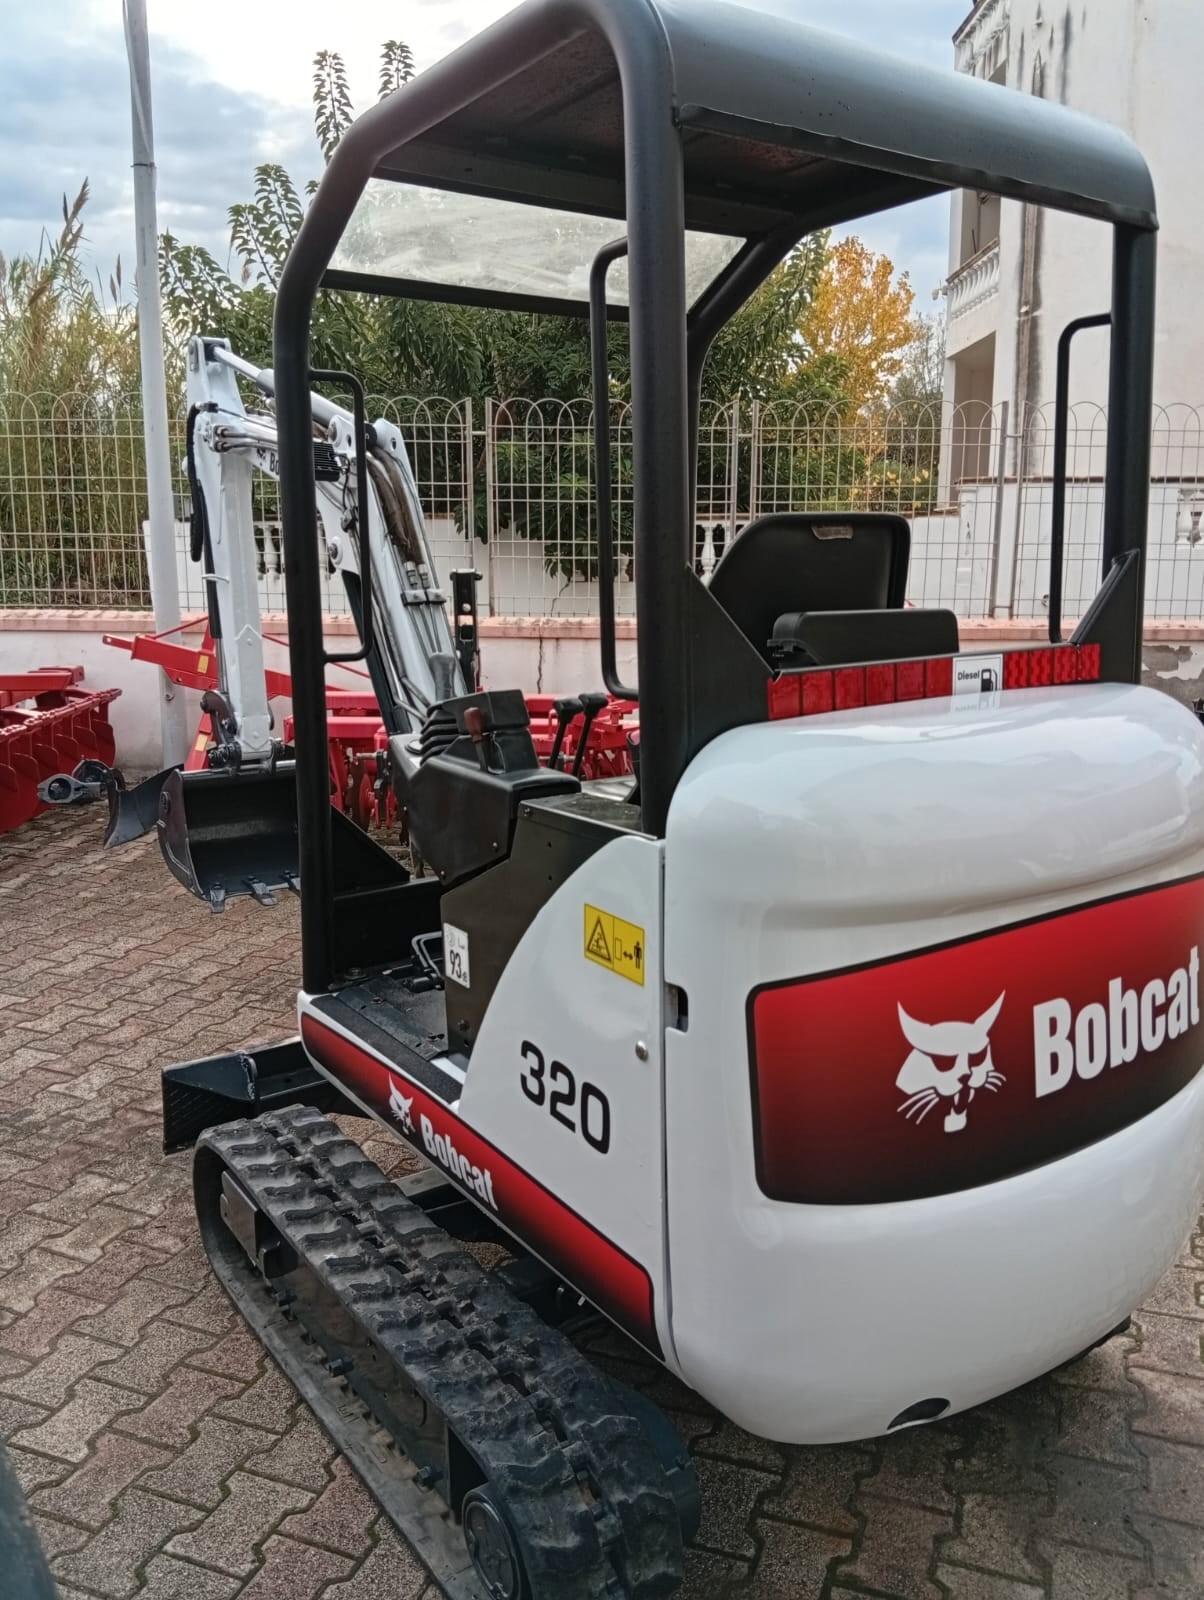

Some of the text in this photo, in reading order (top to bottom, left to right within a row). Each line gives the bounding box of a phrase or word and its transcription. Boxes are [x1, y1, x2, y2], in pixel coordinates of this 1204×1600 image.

[957, 669, 980, 681] Diesel
[1032, 944, 1200, 1098] Bobcat
[520, 1039, 611, 1155] 320
[420, 1113, 499, 1211] Bobcat
